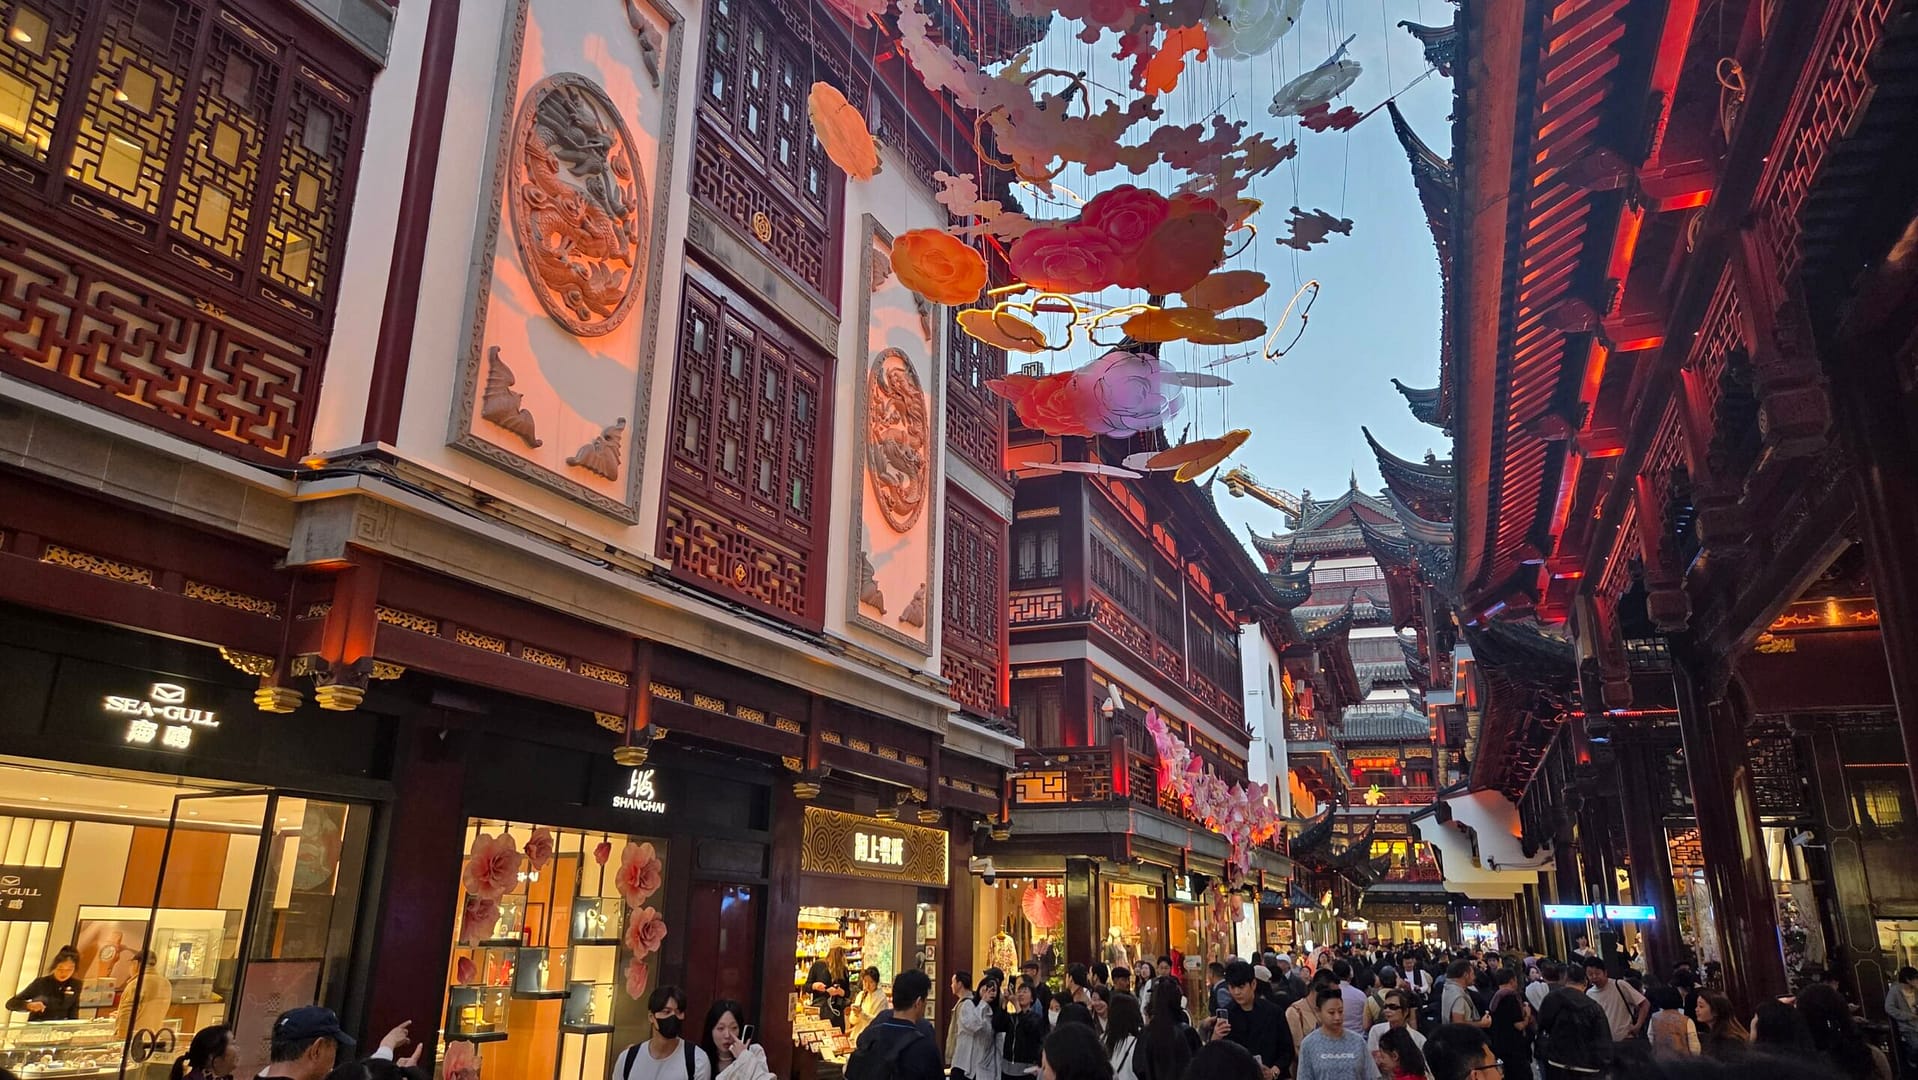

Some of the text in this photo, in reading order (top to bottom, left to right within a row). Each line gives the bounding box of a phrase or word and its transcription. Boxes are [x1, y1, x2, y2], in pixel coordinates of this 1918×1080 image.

[104, 696, 219, 727] SEA-GULL
[612, 796, 665, 813] SHANGHAI
[0, 887, 42, 897] -GULL
